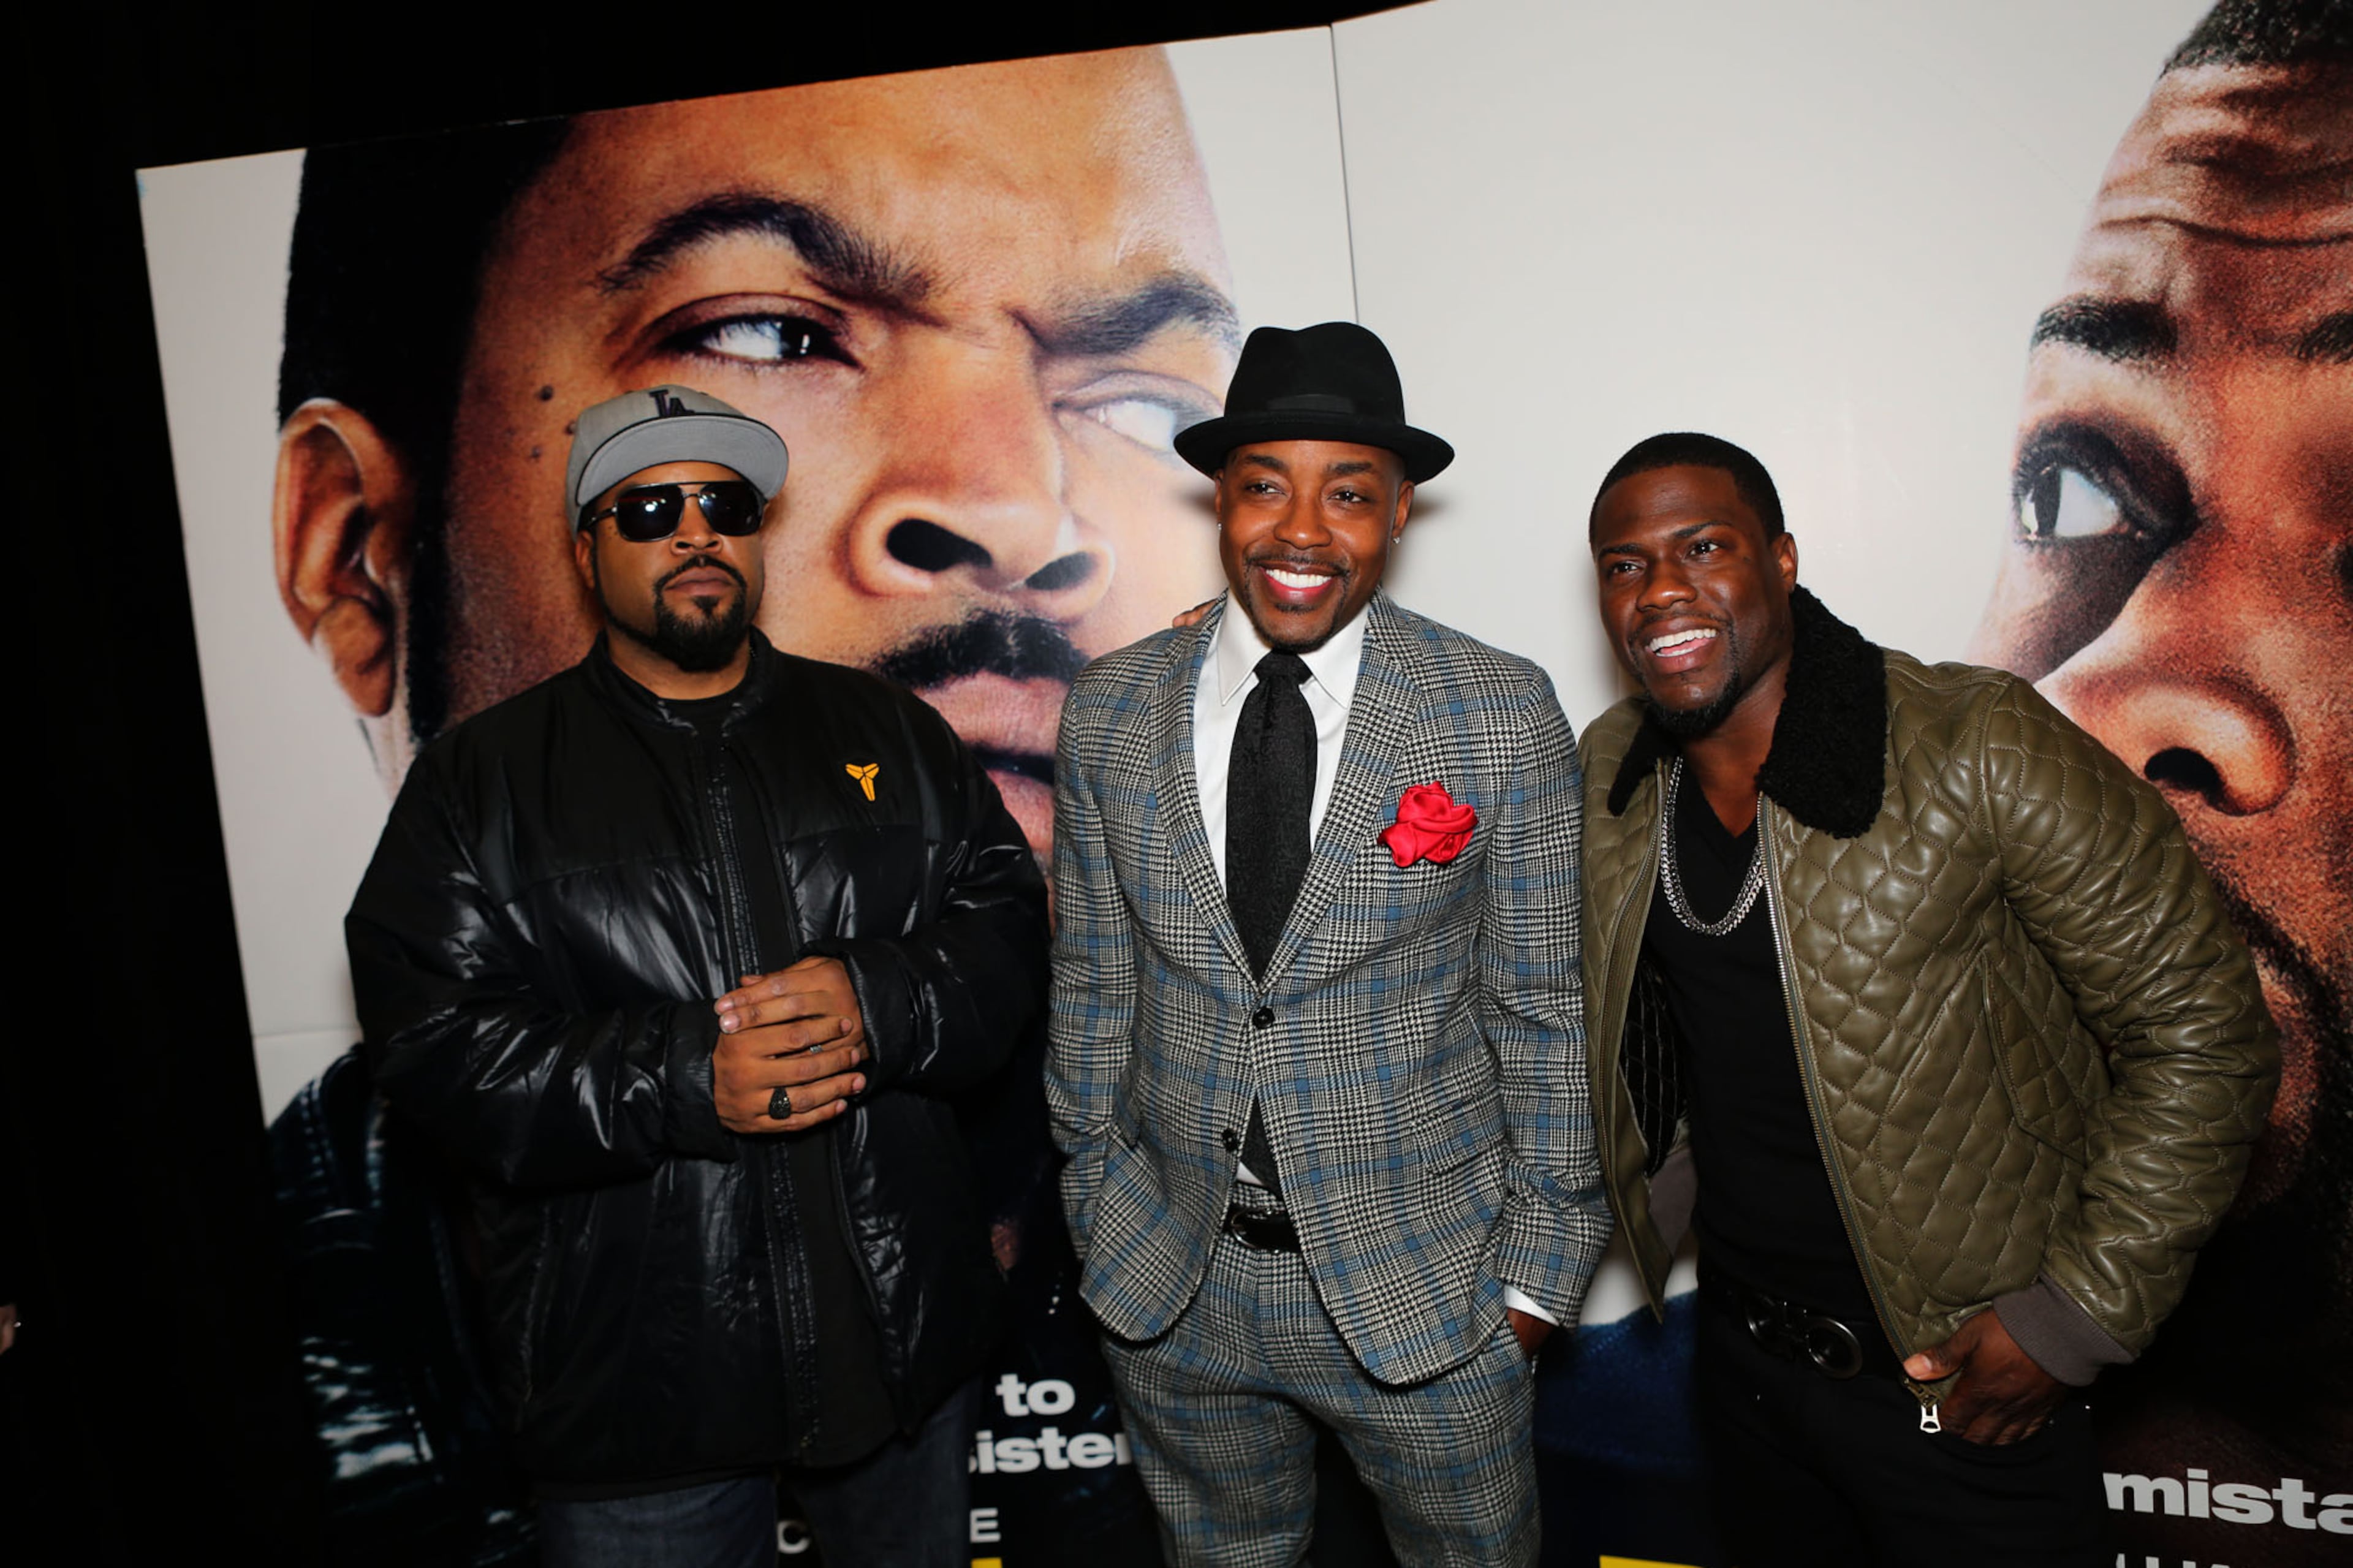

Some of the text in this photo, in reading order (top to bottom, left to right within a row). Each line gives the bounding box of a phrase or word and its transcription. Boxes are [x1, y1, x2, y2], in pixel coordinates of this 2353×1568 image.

[648, 388, 696, 417] LA
[995, 1373, 1075, 1417] to
[969, 1426, 1132, 1474] iste
